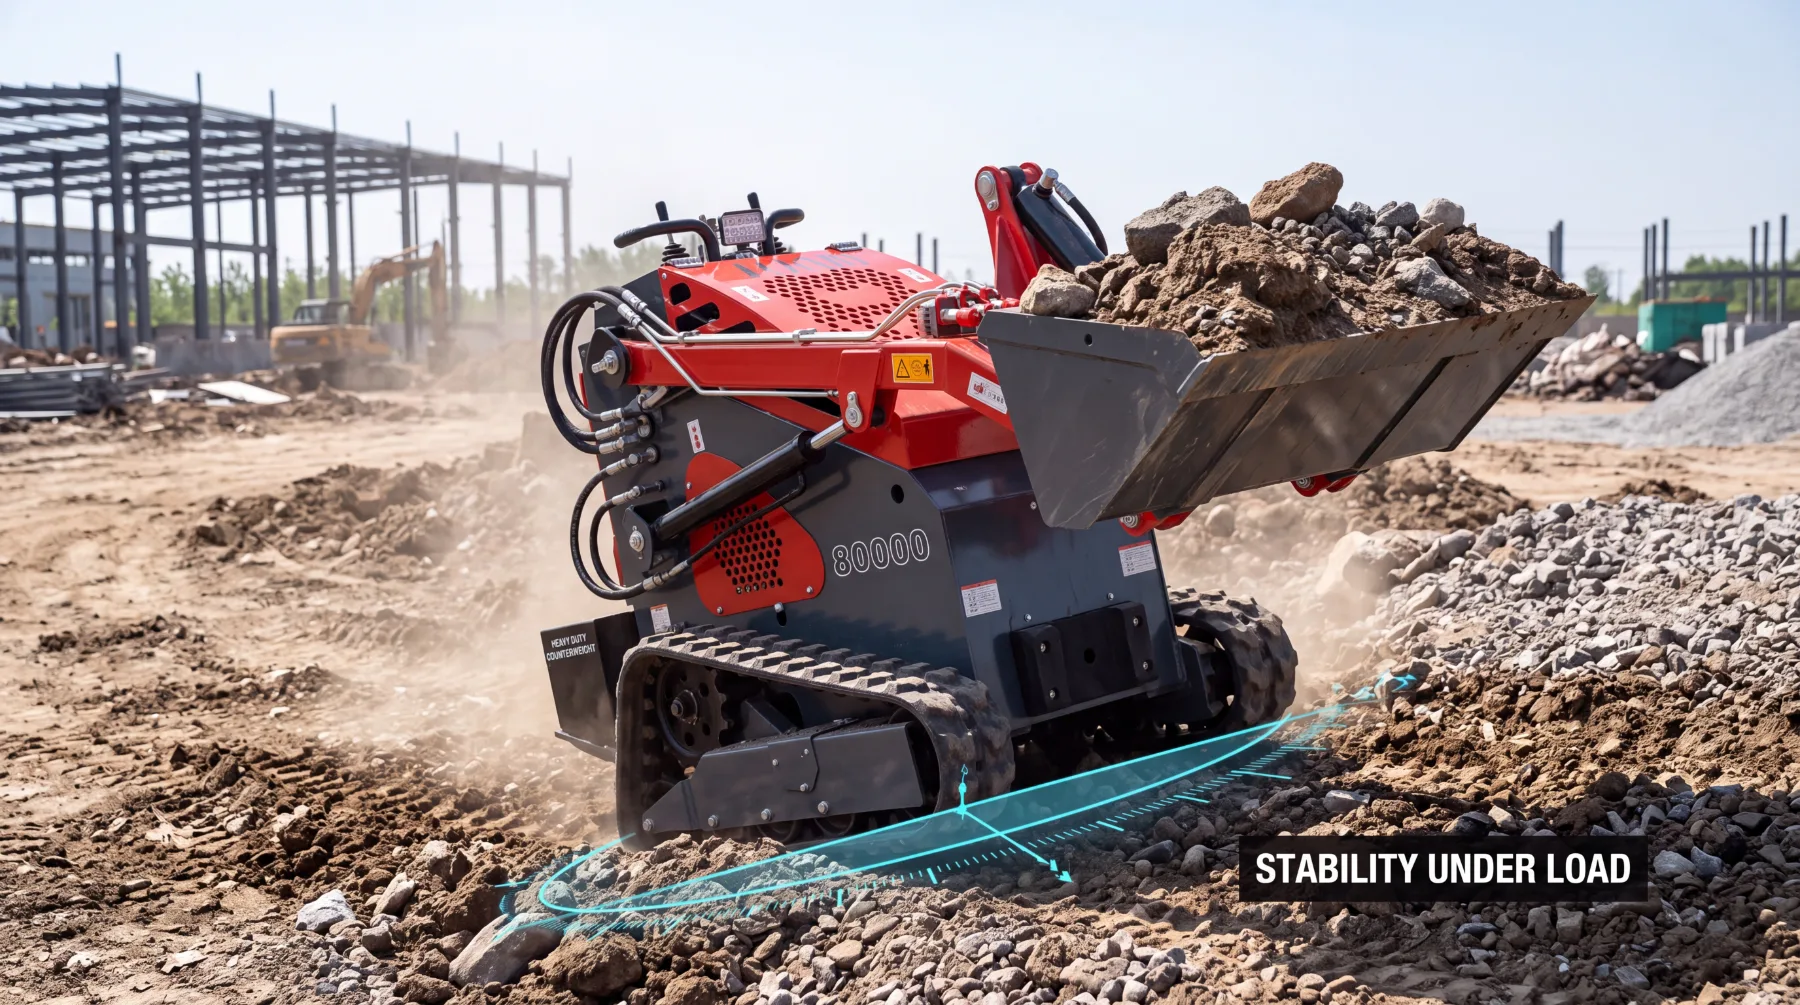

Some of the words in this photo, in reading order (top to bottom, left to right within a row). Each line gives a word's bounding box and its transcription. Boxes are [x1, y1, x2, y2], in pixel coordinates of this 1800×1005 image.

[832, 528, 930, 577] 80000
[551, 636, 570, 648] HEAVY
[571, 633, 587, 644] DUTY
[546, 643, 596, 661] COUNTERWEIGHT
